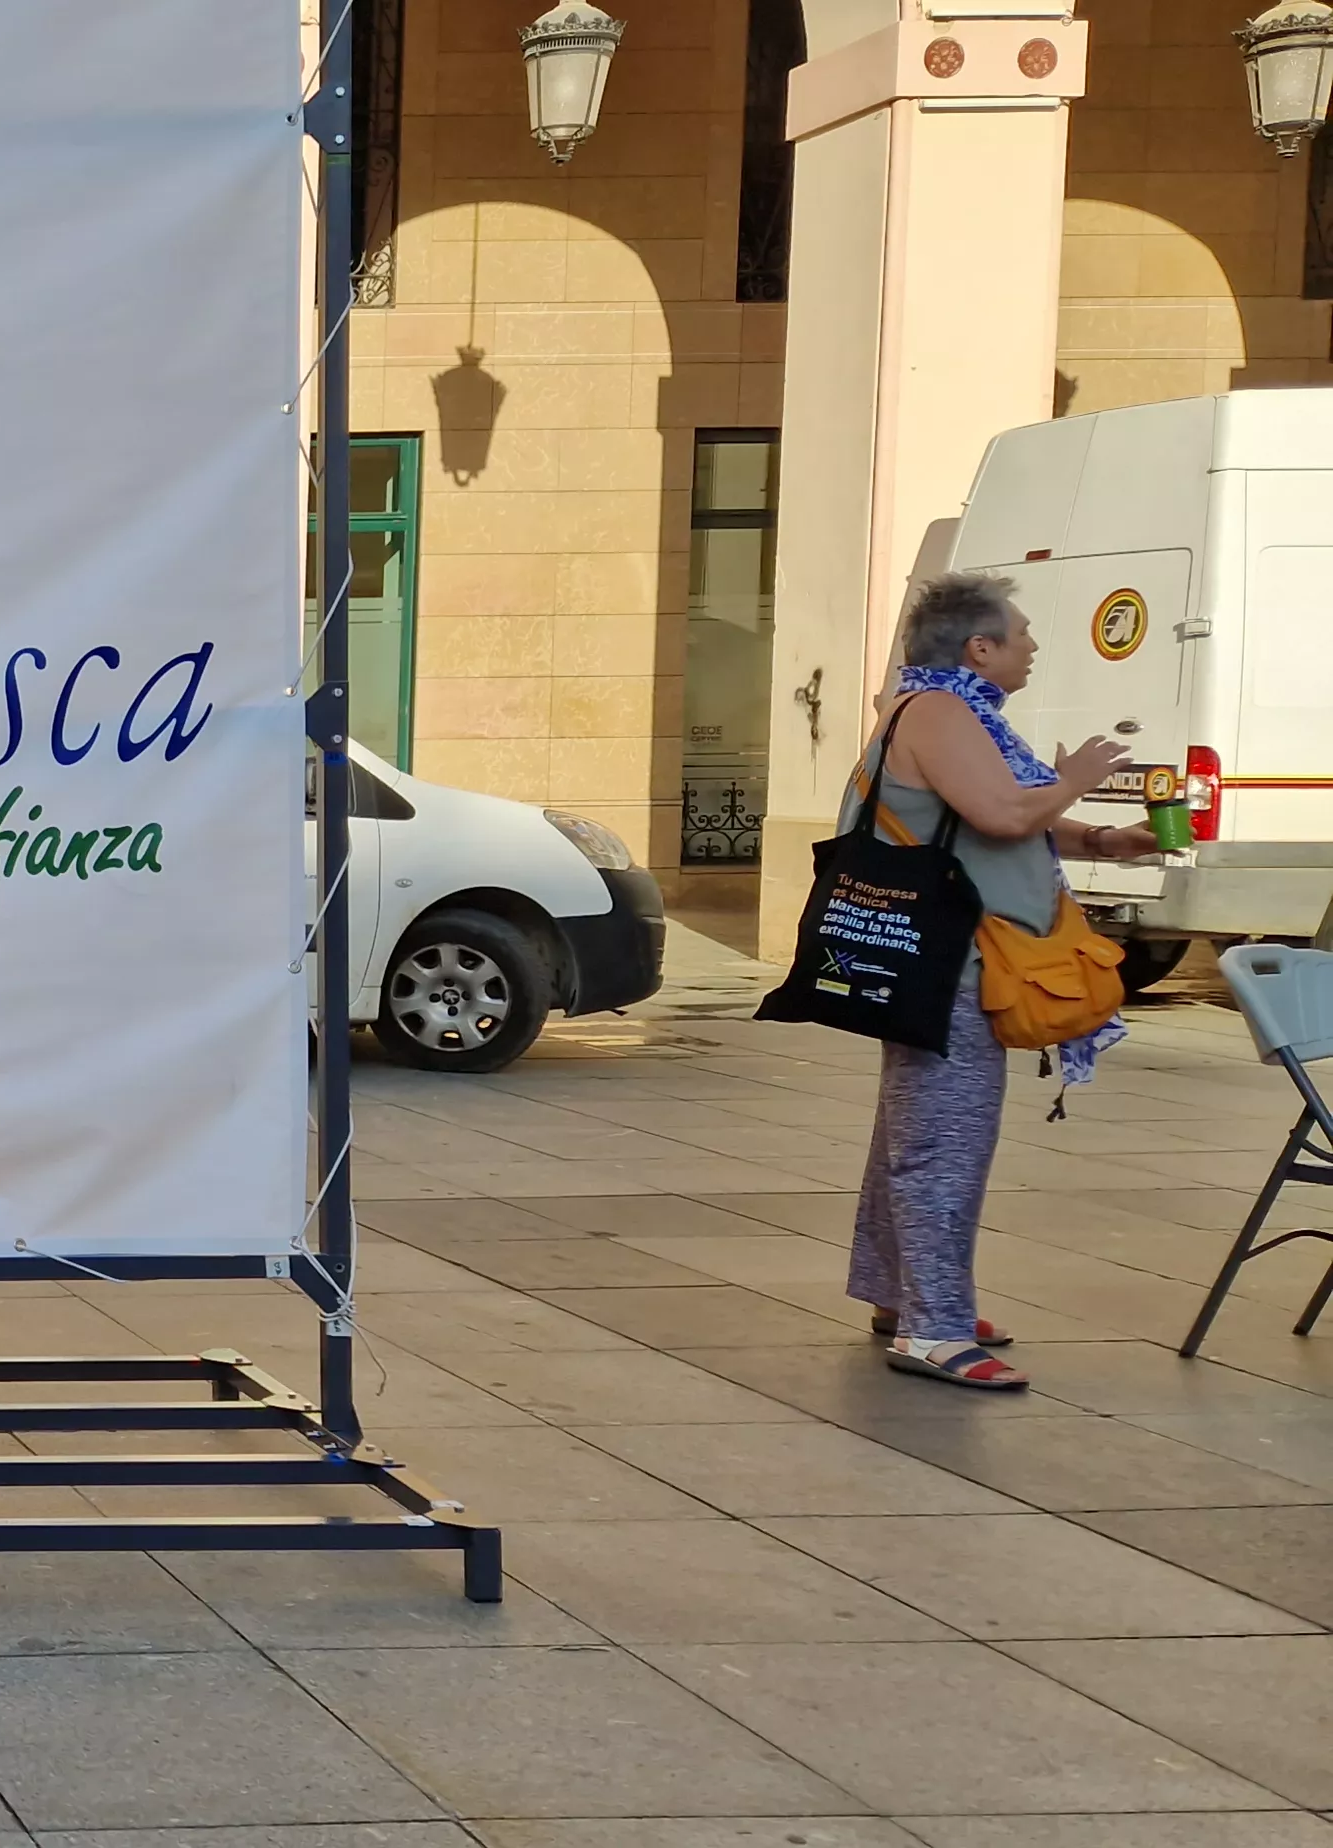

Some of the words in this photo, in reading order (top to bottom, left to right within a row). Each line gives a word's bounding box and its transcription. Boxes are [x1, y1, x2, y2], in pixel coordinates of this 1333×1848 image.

[833, 888, 847, 898] es
[838, 873, 853, 886] Tu
[855, 881, 918, 900] empresa
[828, 898, 876, 919] Marcar
[878, 911, 911, 925] esta
[818, 924, 921, 956] extraordinaria.
[823, 912, 865, 930] casilla
[868, 920, 882, 933] la
[884, 923, 921, 941] hace
